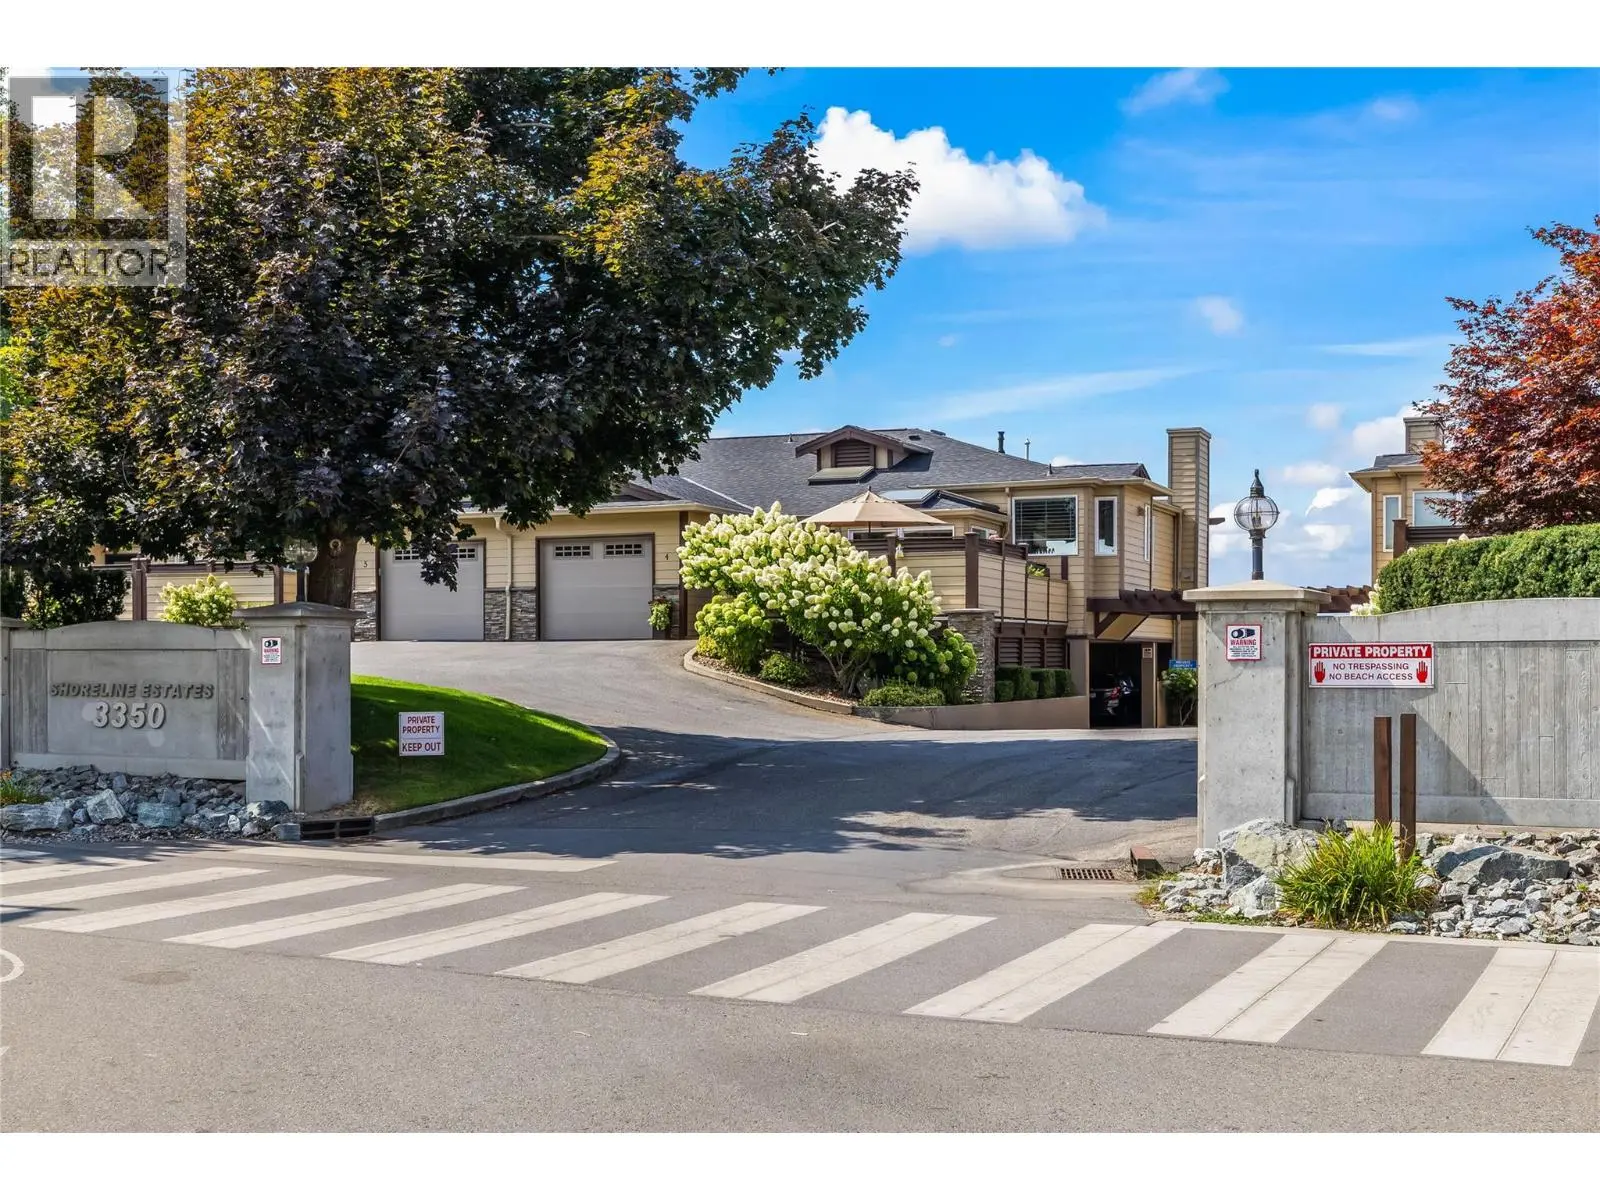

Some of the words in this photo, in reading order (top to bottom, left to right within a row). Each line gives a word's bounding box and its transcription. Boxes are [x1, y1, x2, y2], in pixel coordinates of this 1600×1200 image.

[1313, 646, 1362, 658] PRIVATE
[1365, 645, 1428, 658] PROPERTY
[1333, 662, 1346, 670] NO
[1348, 662, 1409, 671] TRESPASSING
[1329, 673, 1342, 681] NO
[1344, 672, 1375, 681] BEACH
[1378, 672, 1413, 680] ACCESS
[51, 683, 138, 699] SHORELINE
[142, 684, 214, 700] ESTATES
[93, 701, 166, 729] 3350
[407, 716, 436, 724] PRIVATE
[402, 725, 440, 734] PROPERTY
[402, 742, 422, 752] KEEP
[424, 742, 441, 751] OUT
